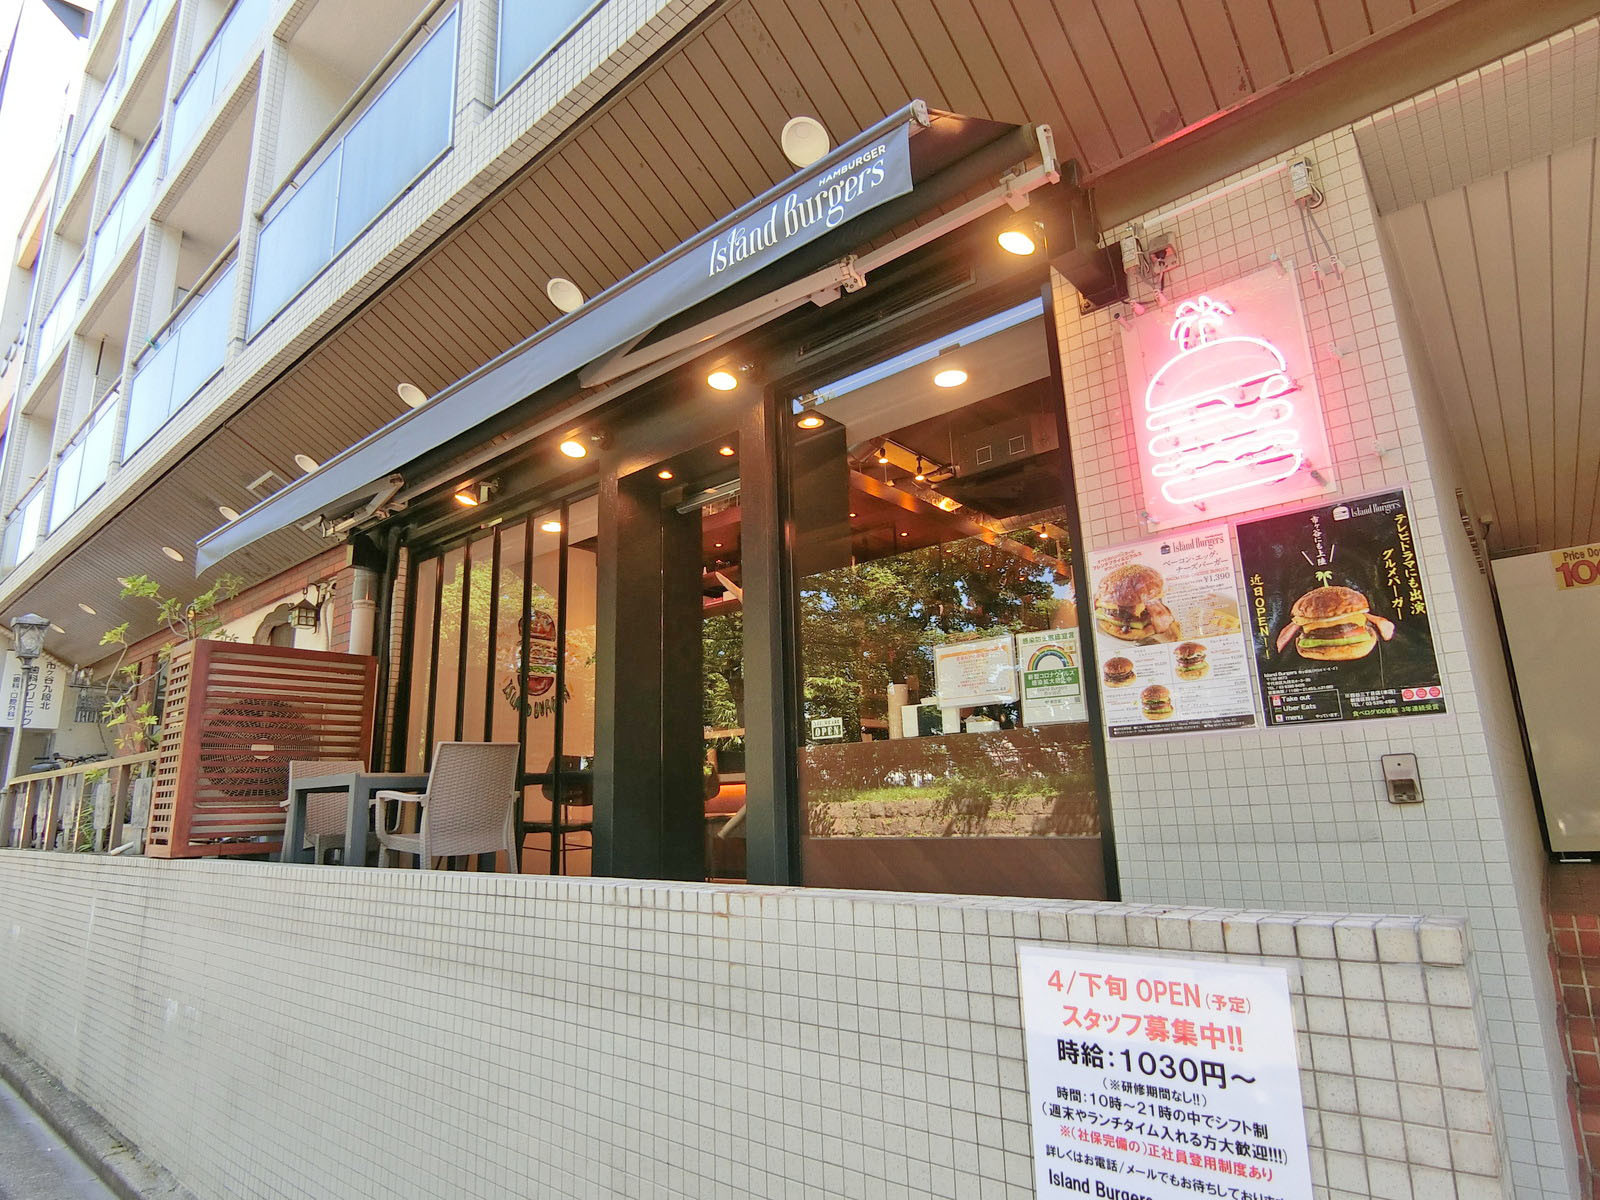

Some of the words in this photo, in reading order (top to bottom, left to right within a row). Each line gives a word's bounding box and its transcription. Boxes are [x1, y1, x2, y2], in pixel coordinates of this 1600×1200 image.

[818, 144, 887, 187] HAMBURGER
[708, 202, 779, 278] Island
[1351, 505, 1372, 518] Island
[1373, 503, 1401, 516] Burgers
[1172, 538, 1195, 553] Island
[1562, 552, 1585, 562] Price
[1203, 572, 1231, 583] ¥1,390
[1394, 513, 1426, 616] テレビドラマにも出演
[1382, 548, 1403, 620] グルメバーガー
[40, 661, 56, 710] 市ヶ谷九段北
[1299, 694, 1312, 702] out
[814, 725, 840, 737] OPEN
[1285, 714, 1304, 722] menu
[1136, 978, 1201, 1008] OPEN
[1062, 1004, 1244, 1052] スタッフ募集中!!
[1049, 1168, 1090, 1195] Island
